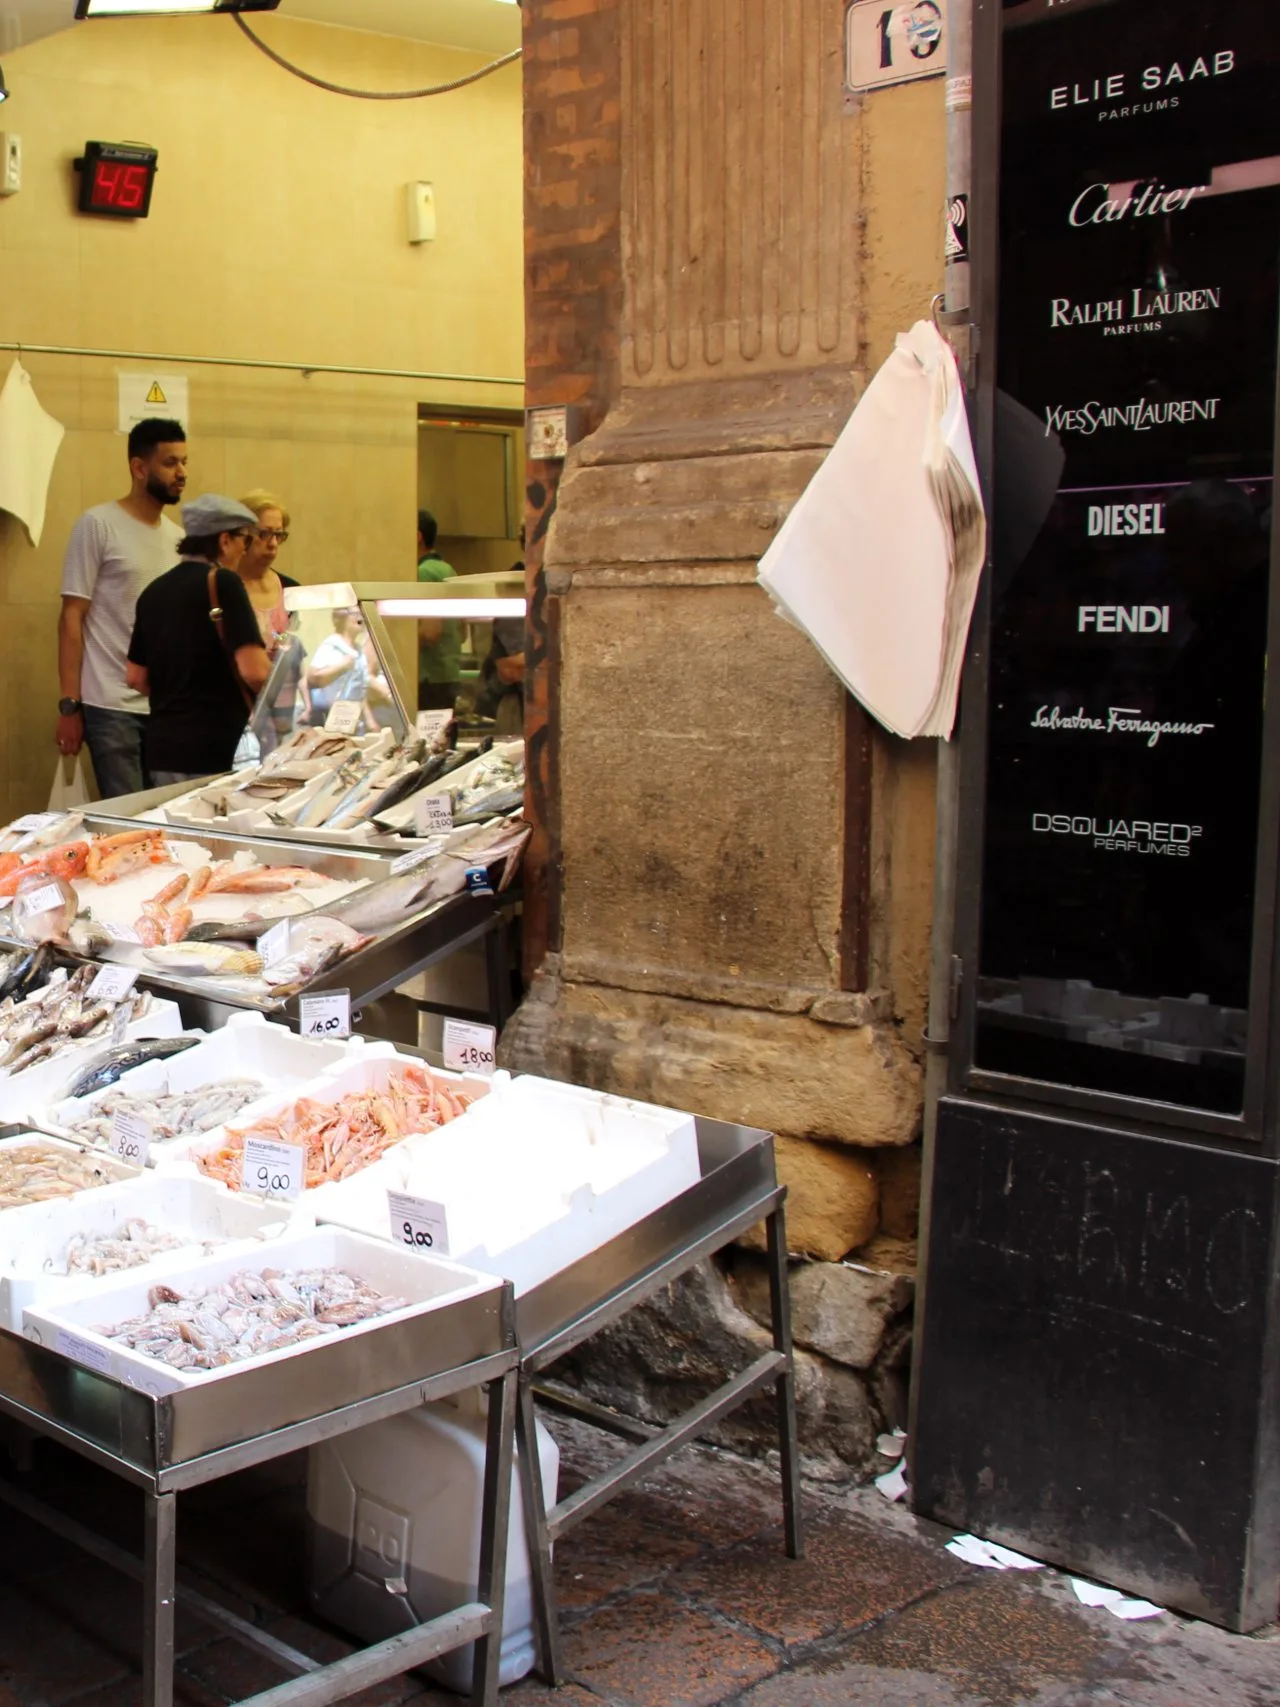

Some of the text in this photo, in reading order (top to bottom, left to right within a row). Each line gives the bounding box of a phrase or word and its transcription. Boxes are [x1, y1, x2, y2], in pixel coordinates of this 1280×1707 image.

[1051, 50, 1235, 110] ELIE SAAB
[1098, 97, 1180, 121] PARFUMS
[96, 163, 148, 208] 45
[1068, 183, 1207, 227] Cartier
[1051, 287, 1221, 328] RALPH LAUREN
[1103, 321, 1162, 336] PARFUMS
[1087, 503, 1166, 537] DIESEL
[1078, 605, 1170, 633] FENDI
[1030, 705, 1215, 748] Salvatore Ferragamo
[1094, 838, 1190, 857] PERFUMES
[459, 1047, 493, 1068] 18,00
[257, 1166, 290, 1191] 9,00
[403, 1221, 433, 1247] 9,00
